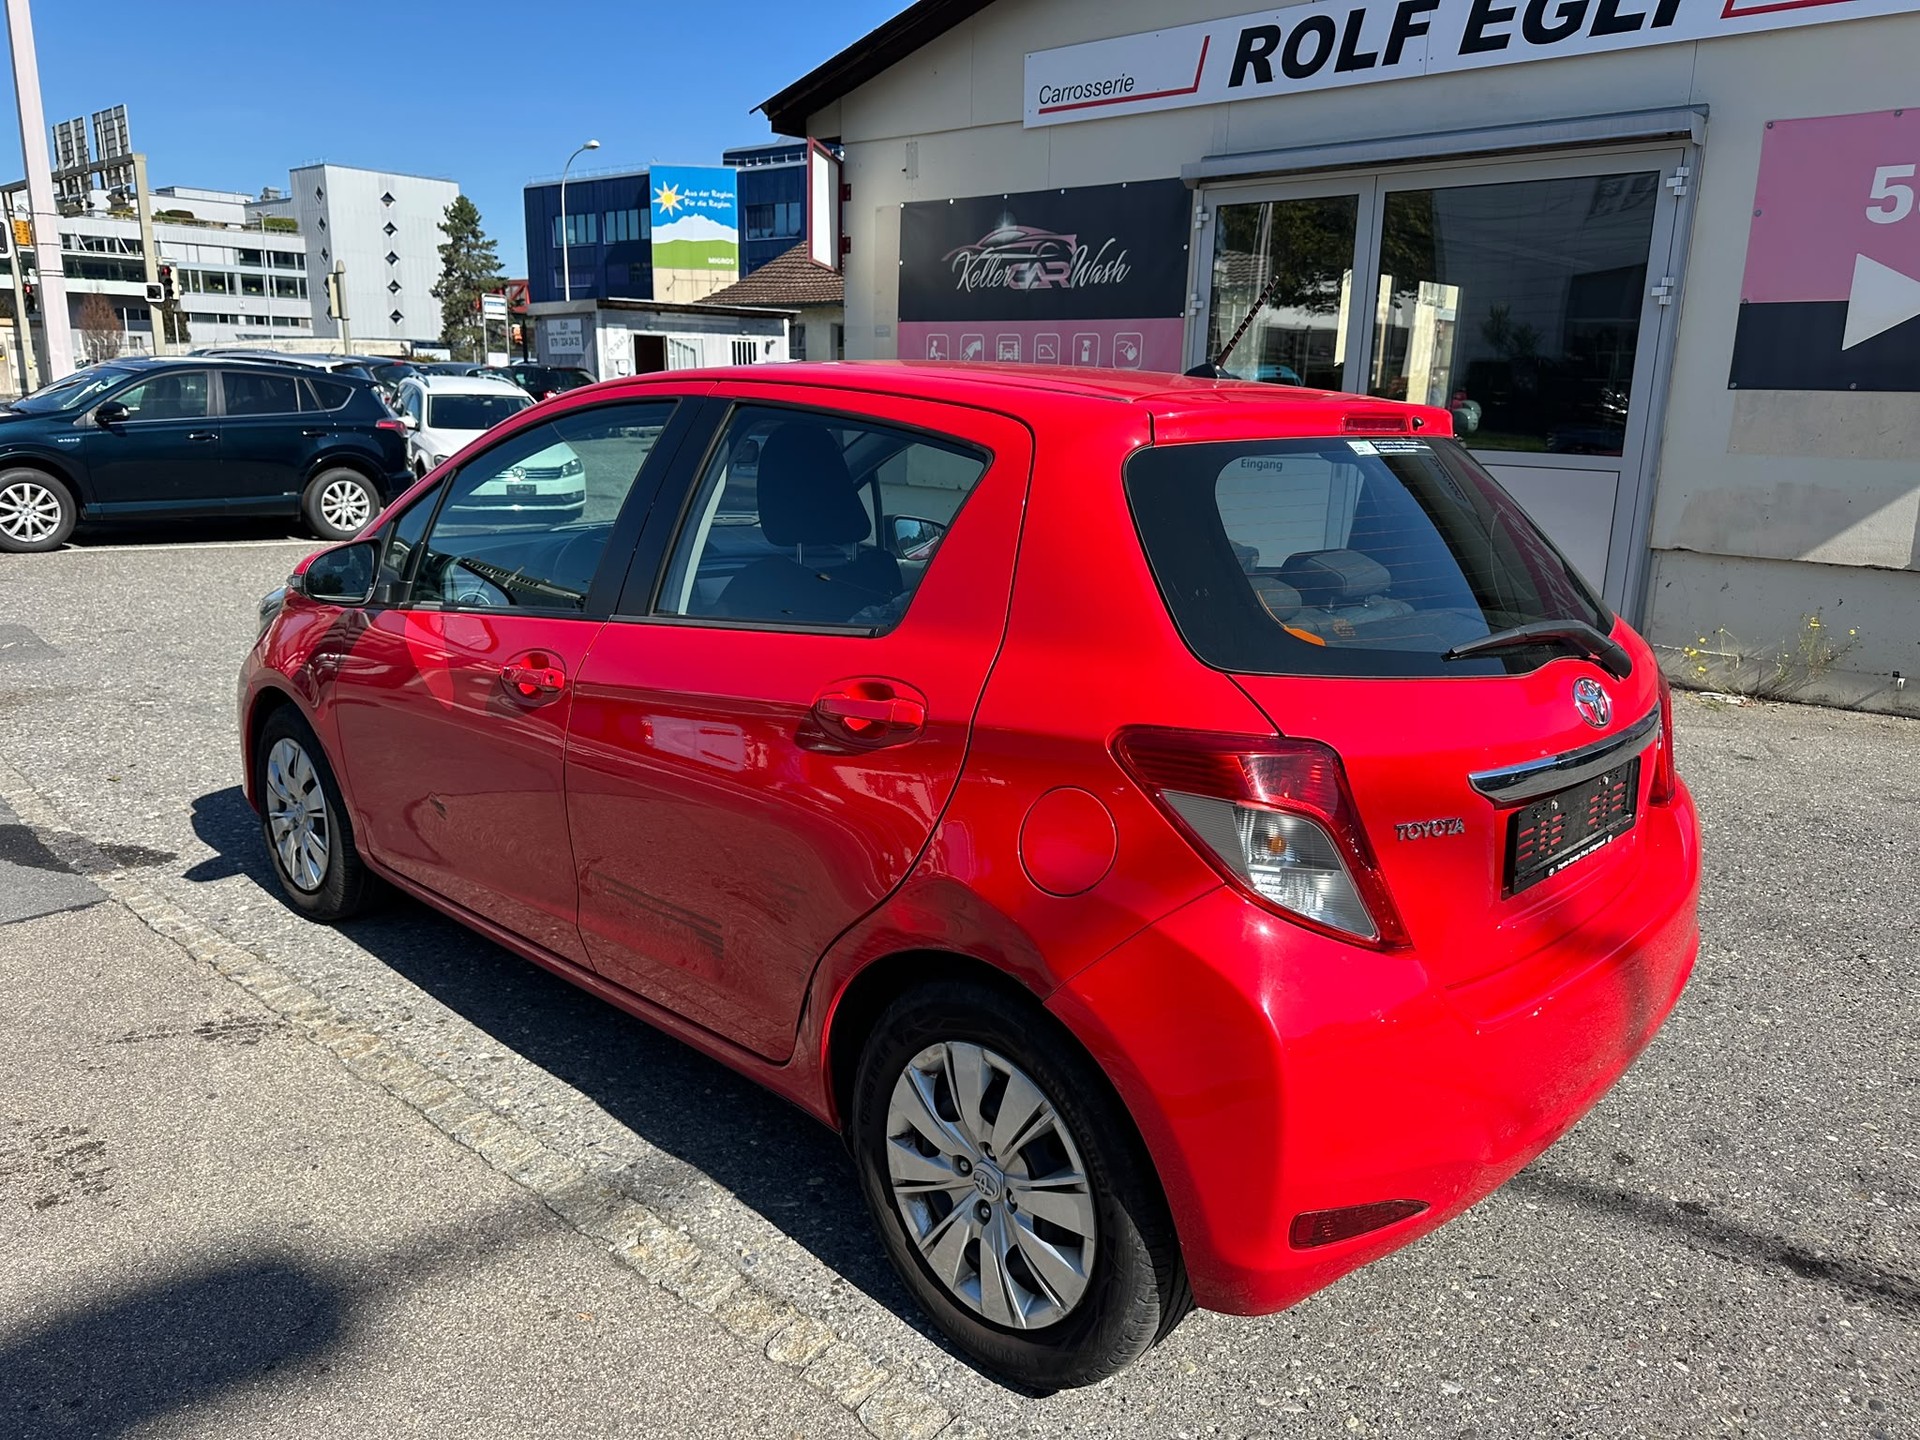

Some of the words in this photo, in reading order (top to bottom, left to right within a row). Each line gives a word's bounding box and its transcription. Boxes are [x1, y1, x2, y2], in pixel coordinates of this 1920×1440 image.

[1228, 0, 1440, 88] ROLF
[1039, 73, 1135, 105] Carrosserie
[684, 189, 697, 197] Aus
[697, 199, 707, 207] die
[708, 257, 735, 265] MIGROS
[952, 246, 1013, 292] Keller
[1069, 237, 1131, 289] Wash
[1240, 458, 1283, 473] Eingang
[1395, 817, 1465, 841] TOYOTA
